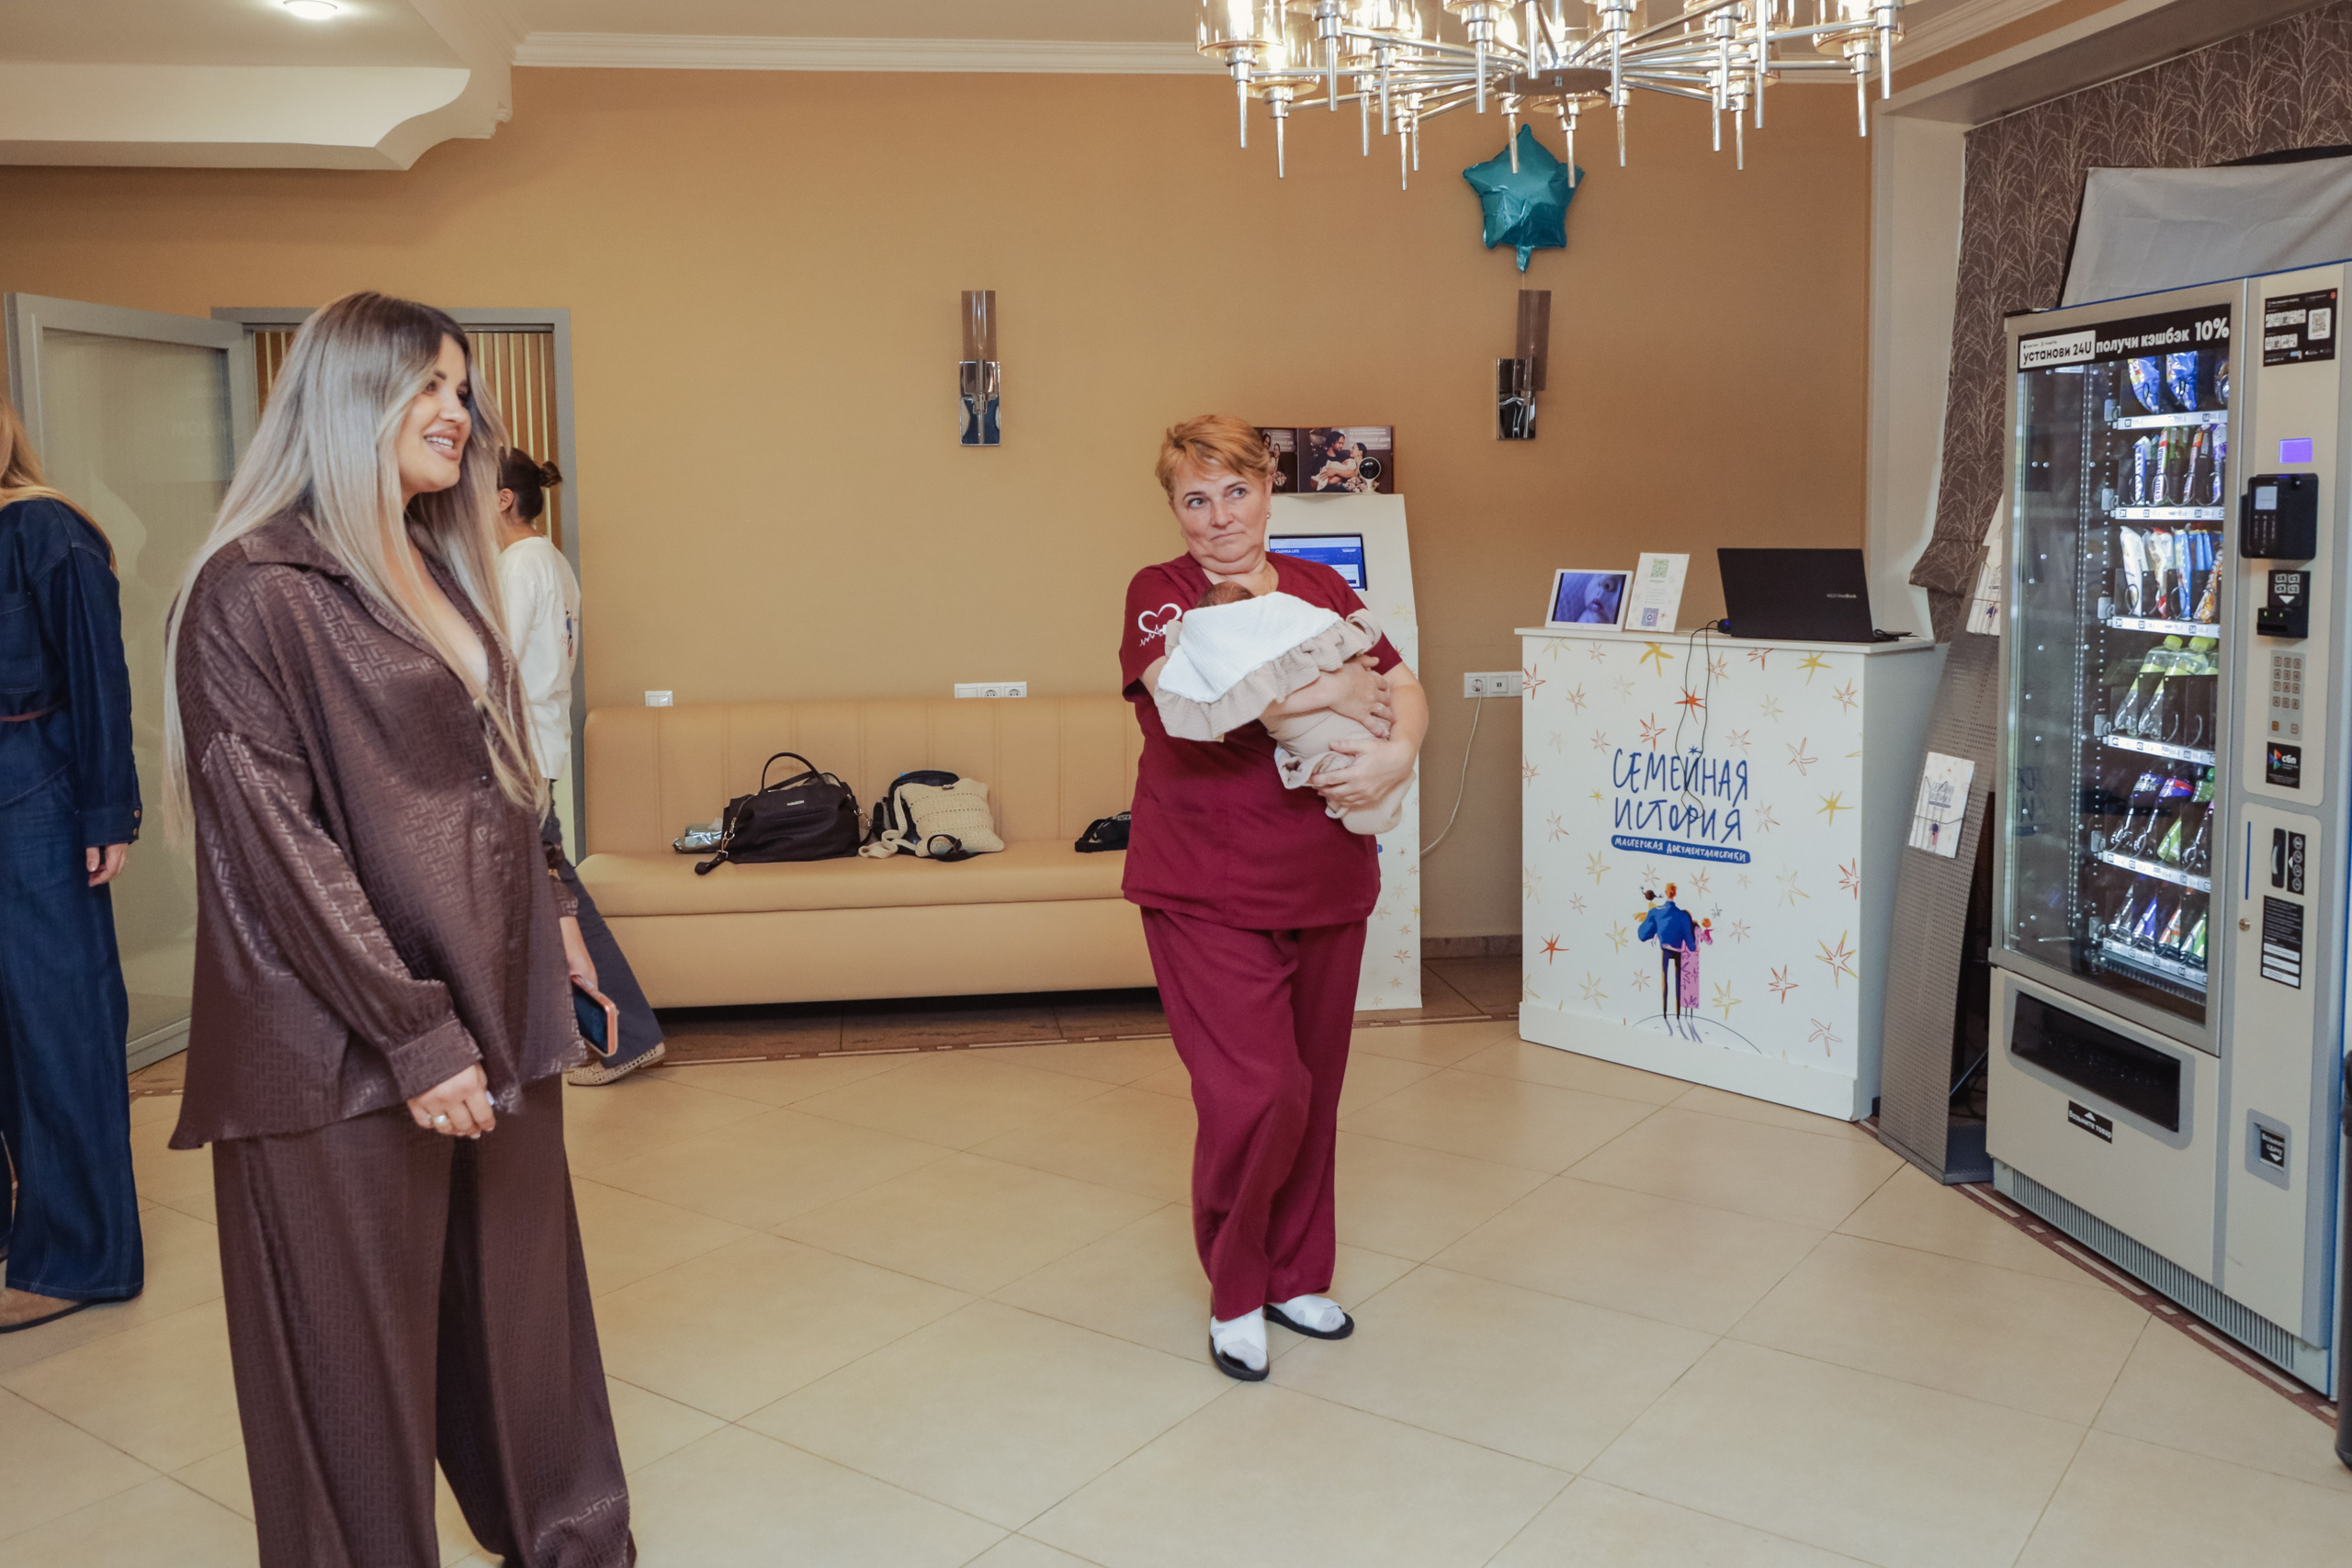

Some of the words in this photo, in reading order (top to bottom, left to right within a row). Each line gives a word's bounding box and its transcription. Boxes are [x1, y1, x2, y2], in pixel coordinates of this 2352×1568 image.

[2023, 346, 2071, 366] установи
[2073, 341, 2092, 355] 24U
[2096, 336, 2139, 354] получи
[2141, 327, 2189, 347] кэшбэк
[2195, 317, 2230, 341] 10%
[1613, 748, 1747, 807] СЕМЕЙНАЯ
[1615, 796, 1742, 843] ИСТОРИЯ
[1614, 837, 1663, 851] МАСТЕРСКАЯ
[1667, 843, 1747, 863] ДОКУМЕНТАЛИСТИКИ
